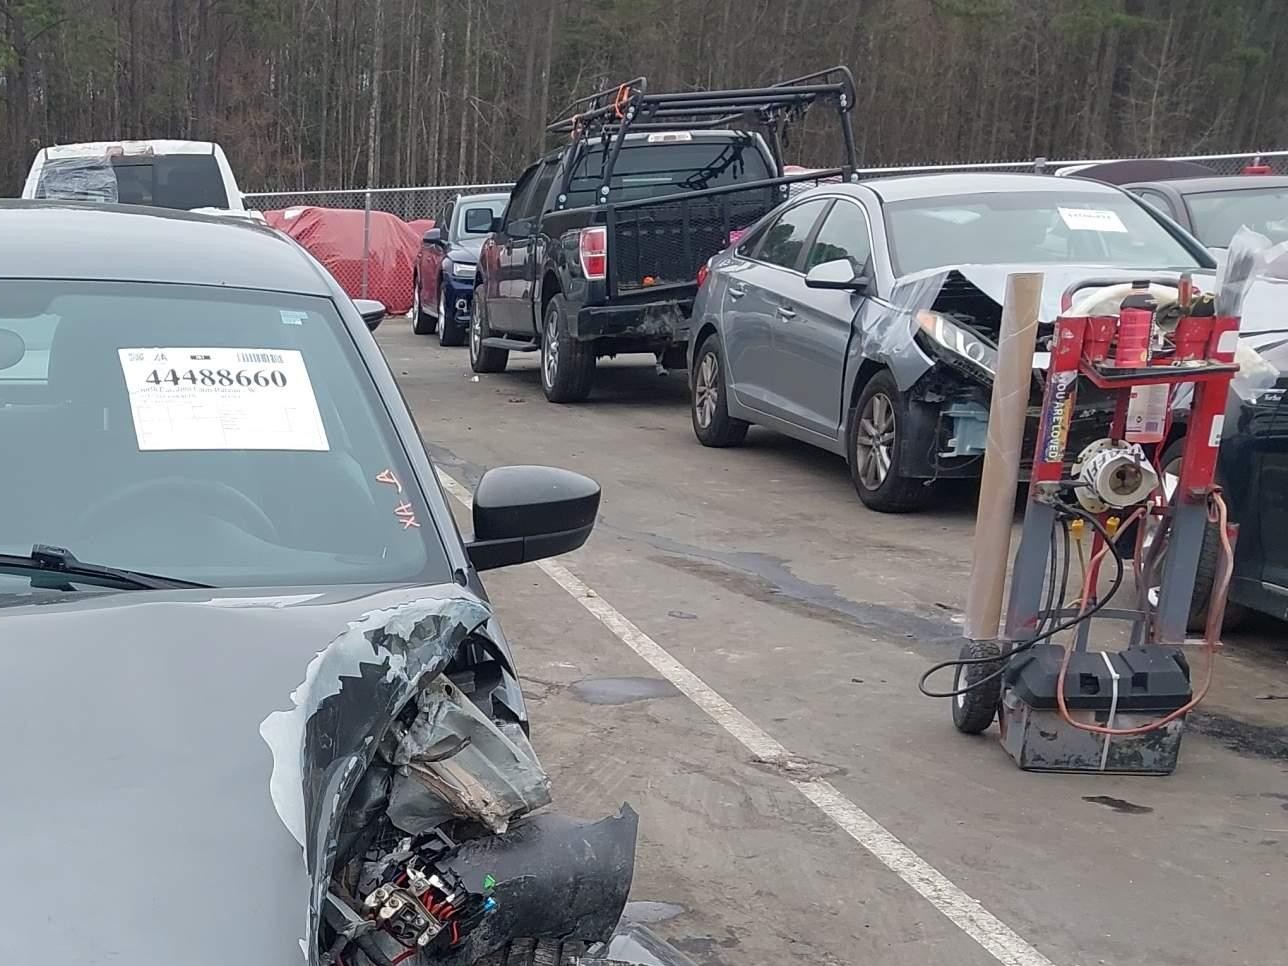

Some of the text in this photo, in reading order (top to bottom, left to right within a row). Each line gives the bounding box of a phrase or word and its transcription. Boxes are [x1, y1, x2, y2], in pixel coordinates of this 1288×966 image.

[145, 368, 288, 388] 44488660
[1053, 401, 1065, 424] ARE
[1048, 424, 1062, 458] LOVED
